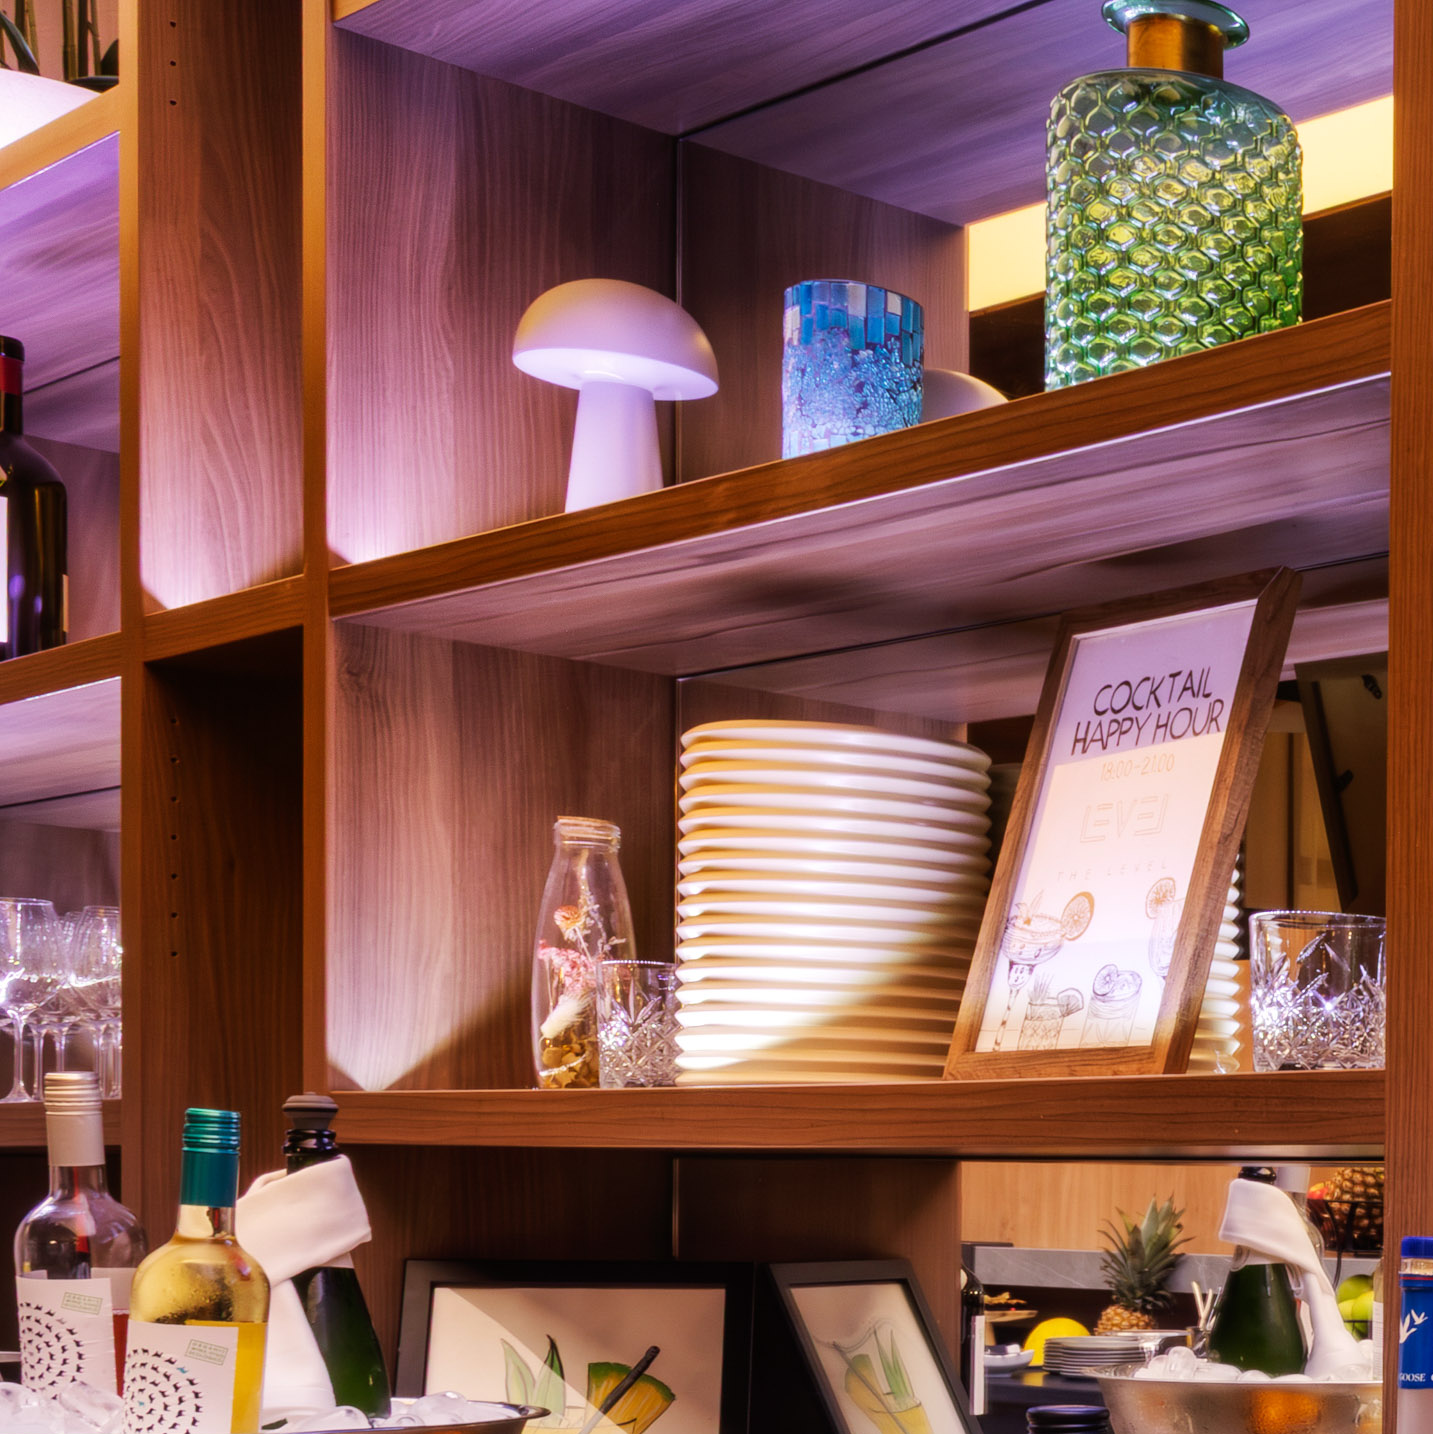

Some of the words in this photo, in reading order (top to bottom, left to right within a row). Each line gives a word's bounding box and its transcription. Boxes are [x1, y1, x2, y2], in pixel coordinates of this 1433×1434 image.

[1093, 667, 1212, 716] COCKTAIL
[1070, 713, 1152, 756] HAPPY
[1152, 699, 1224, 744] HOUR
